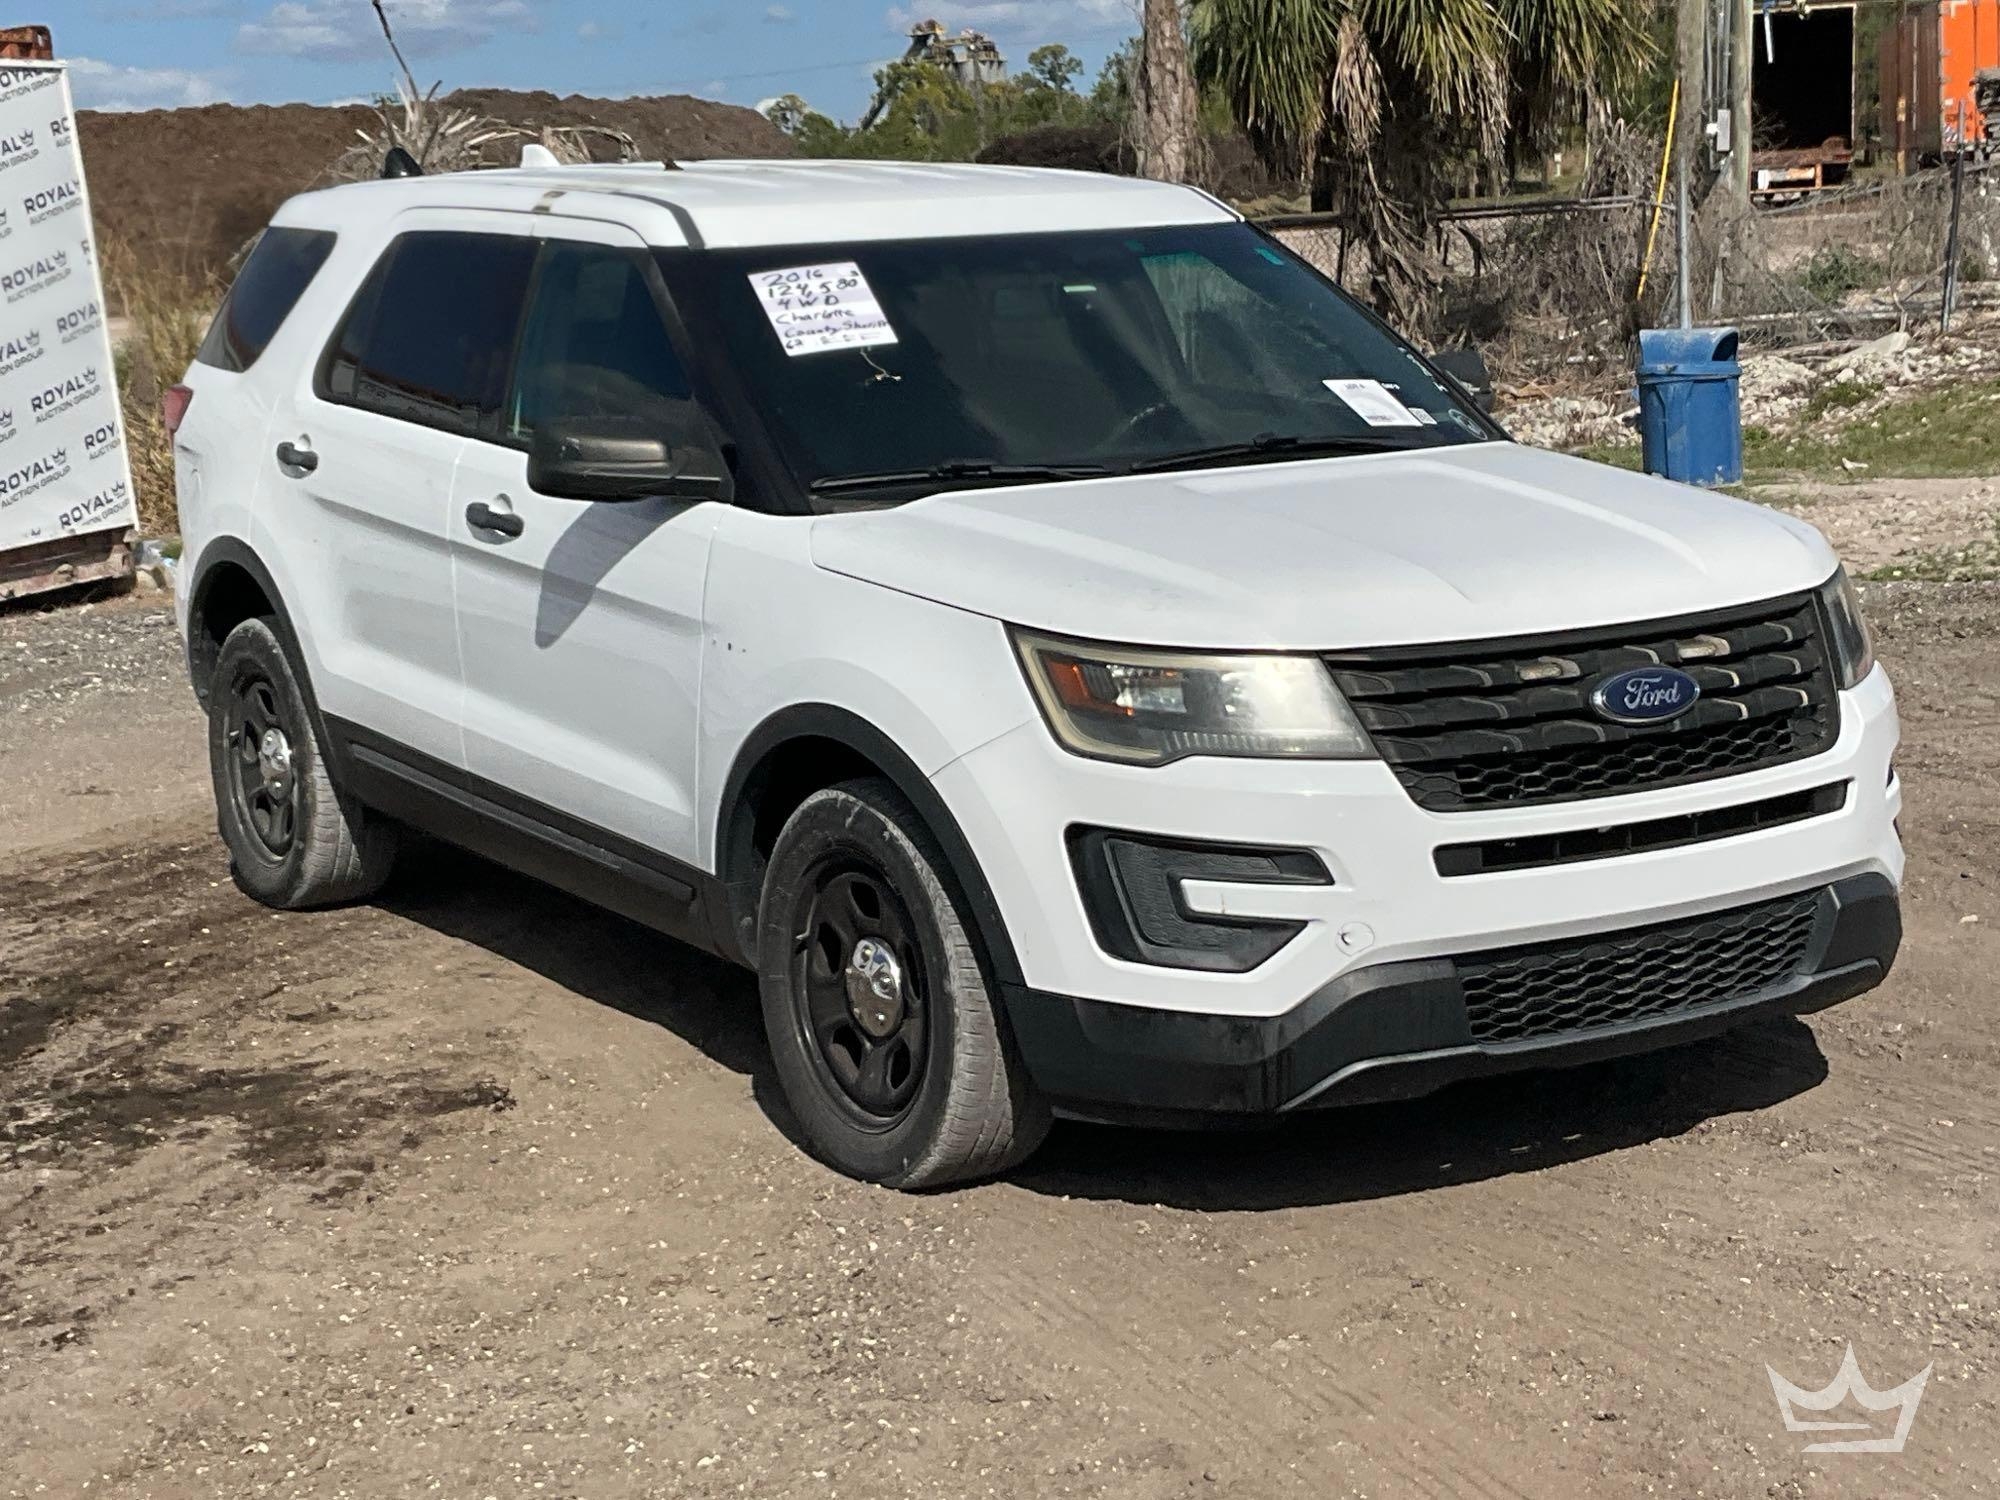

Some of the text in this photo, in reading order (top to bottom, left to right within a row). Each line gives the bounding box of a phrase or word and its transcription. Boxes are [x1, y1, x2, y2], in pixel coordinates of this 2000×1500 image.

[24, 182, 76, 214] ROYAL
[29, 206, 65, 225] AUCTION
[1, 258, 56, 292] ROYAL
[7, 268, 71, 304] AUCTION GROUP
[761, 269, 823, 287] 2016
[61, 323, 96, 344] AUCTION
[14, 347, 45, 368] GROUP
[31, 376, 85, 412] ROYAL
[36, 384, 101, 423] AUCTION GROUP
[84, 422, 116, 450] ROY
[0, 457, 54, 495] ROYAL
[1, 464, 71, 508] AUCTION GROUP
[59, 491, 114, 530] ROYAL
[101, 497, 130, 520] GROUP
[1623, 675, 1681, 710] Ford
